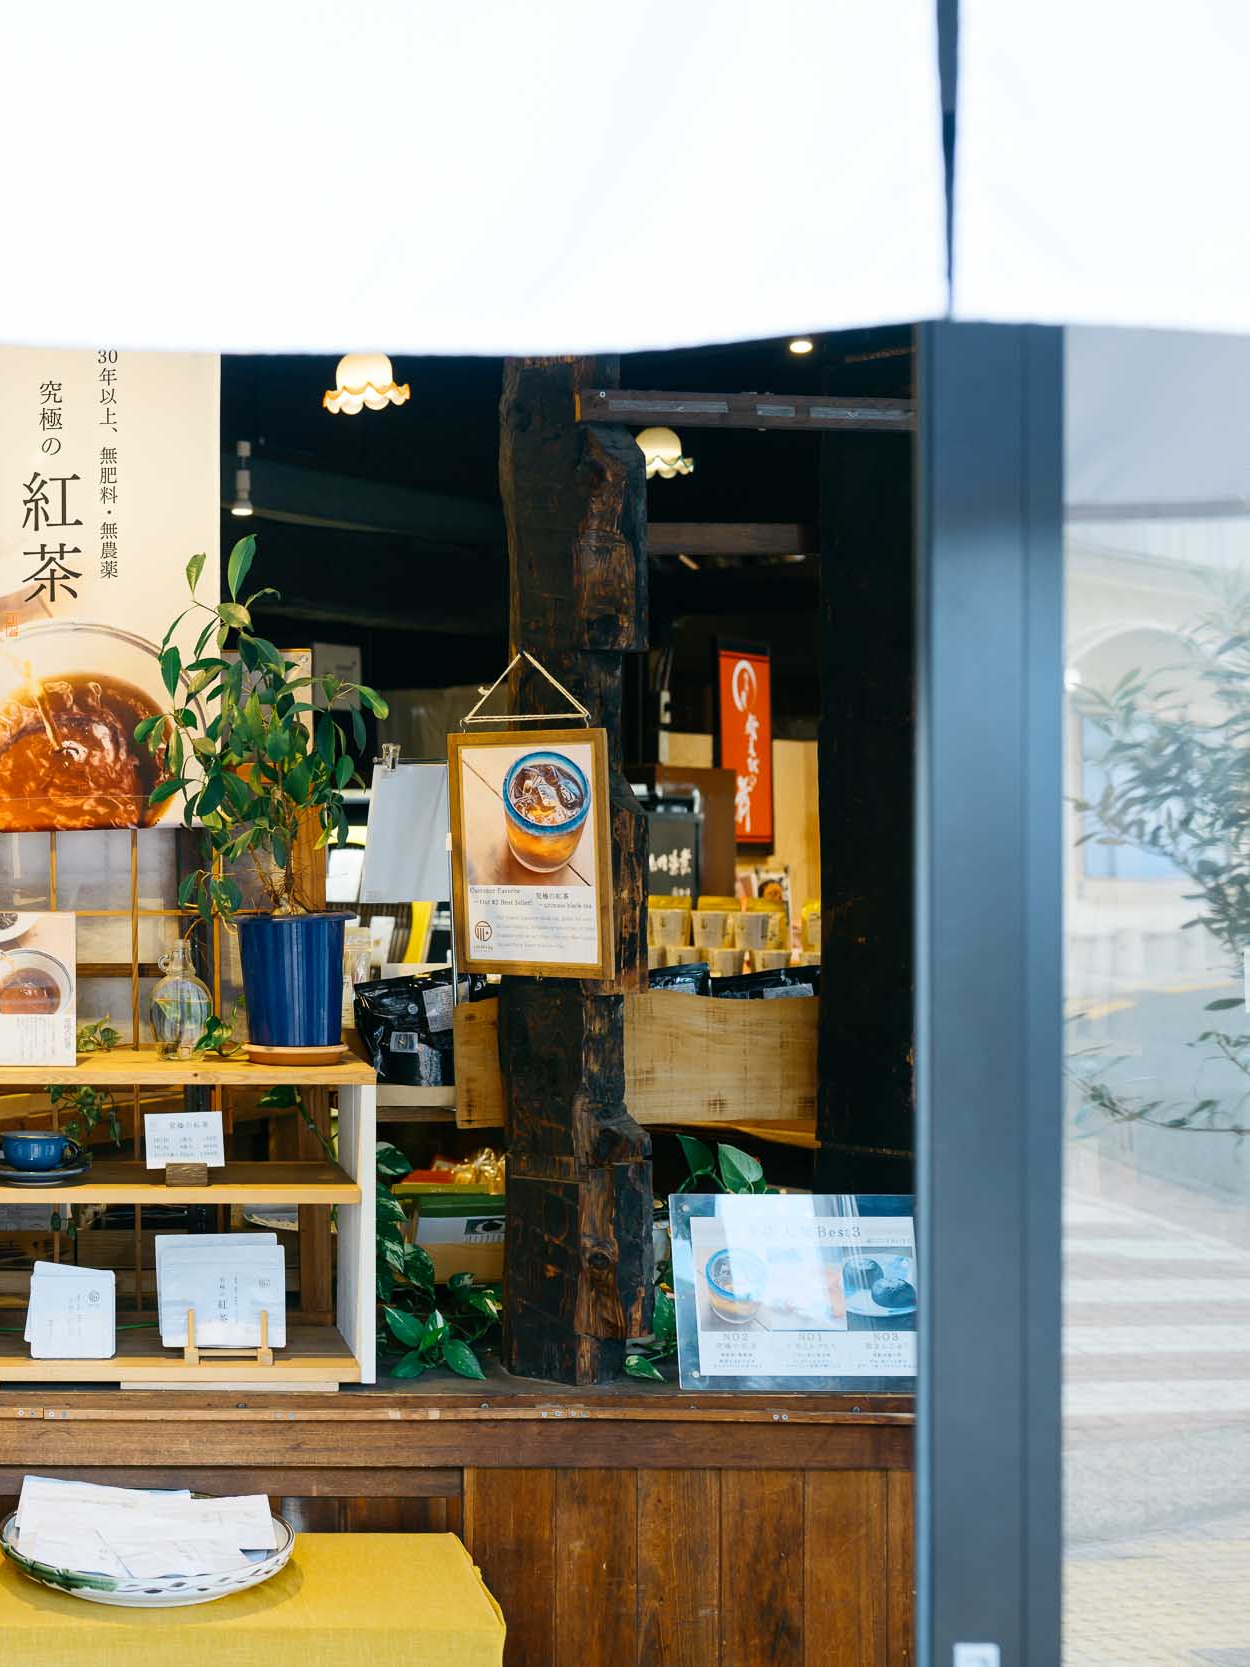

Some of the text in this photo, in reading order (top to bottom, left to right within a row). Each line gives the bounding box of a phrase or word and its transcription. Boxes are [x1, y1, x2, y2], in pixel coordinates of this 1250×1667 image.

[21, 380, 84, 604] 究極の紅茶
